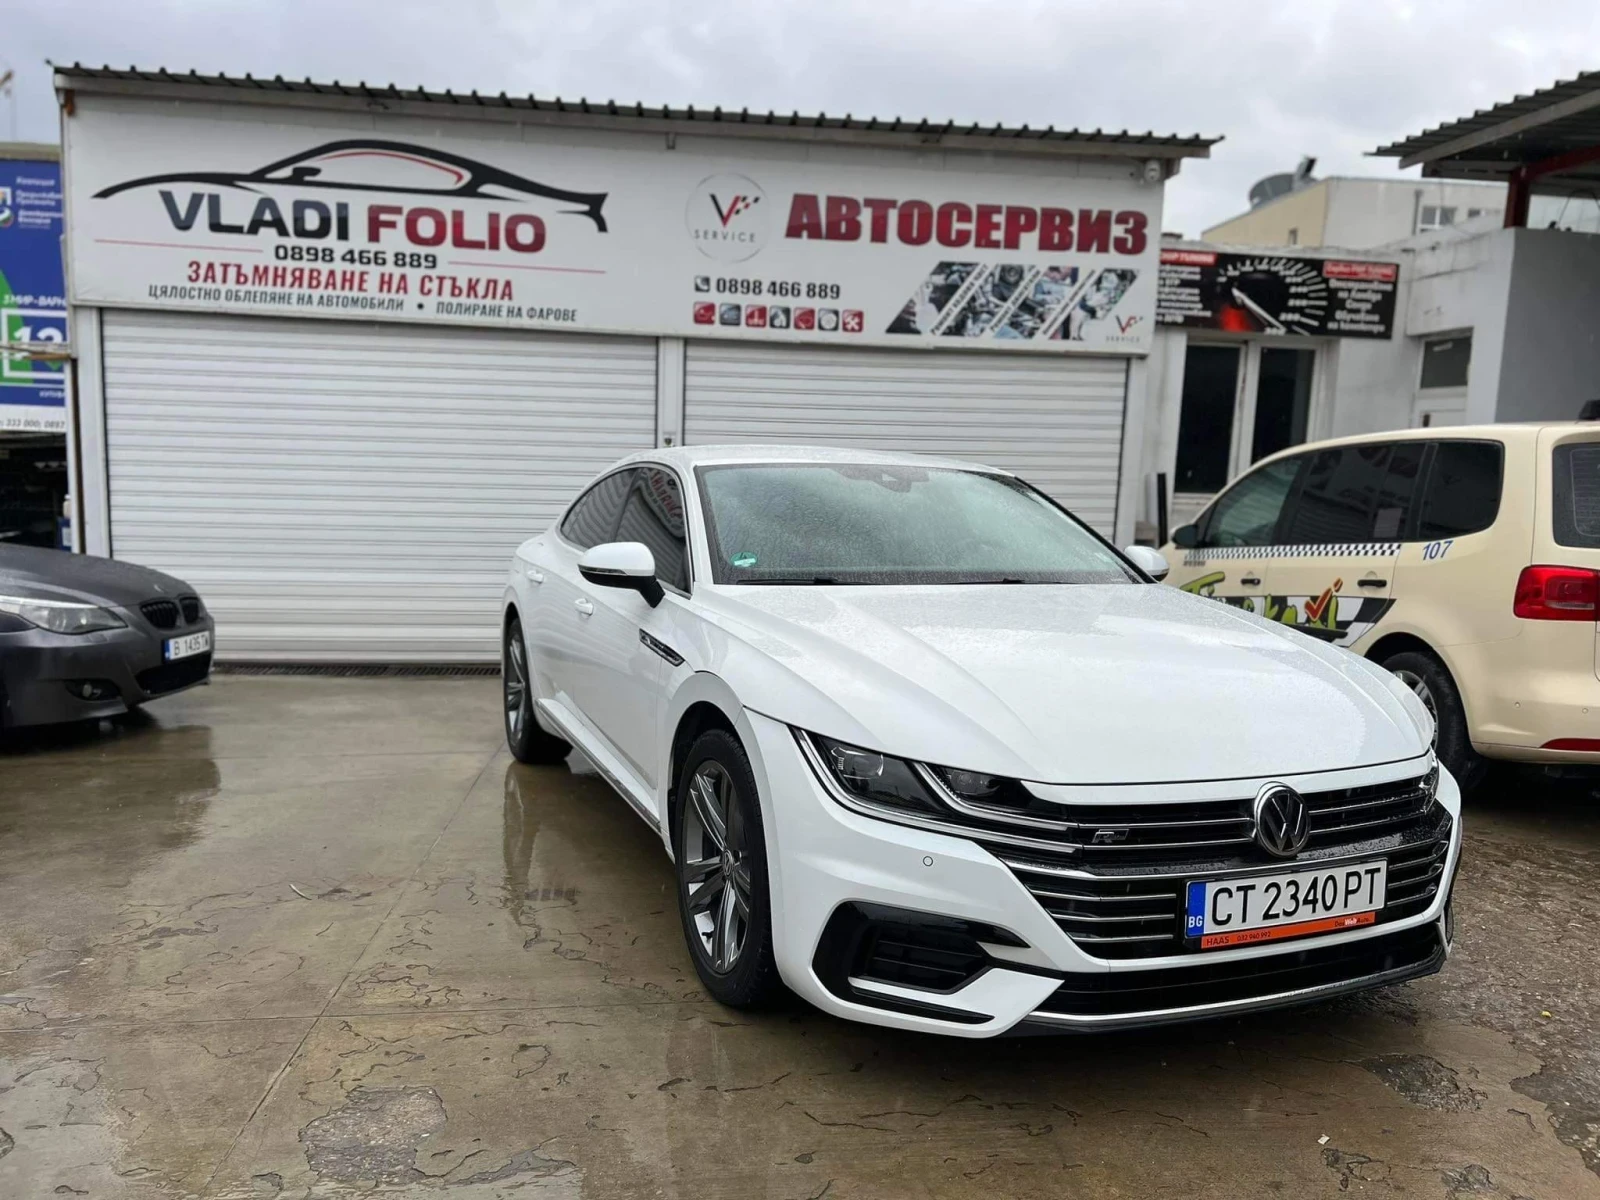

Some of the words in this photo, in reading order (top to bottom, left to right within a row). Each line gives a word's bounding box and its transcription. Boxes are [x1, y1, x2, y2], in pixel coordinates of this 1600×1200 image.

[159, 190, 349, 241] VLADI
[366, 204, 547, 254] FOLIO
[785, 192, 1148, 255] АВТОСЕРВИЗ
[694, 229, 756, 243] SERVICE
[274, 244, 335, 263] 0898
[340, 248, 387, 266] 466
[393, 251, 438, 269] 889
[187, 260, 369, 292] ЗАТЪМНЯВАНЕ
[378, 272, 408, 295] НА
[419, 274, 513, 301] СТЪКЛА
[716, 277, 763, 296] 0898
[767, 280, 802, 298] 466
[806, 283, 841, 300] 889
[148, 285, 221, 301] ЦЯЛОСТНО
[225, 289, 293, 305] ОБЛЕПЯНЕ
[297, 292, 313, 306] НА
[317, 294, 404, 311] АВТОМОБИЛИ
[436, 301, 503, 318] ПОЛИРАНЕ
[506, 305, 523, 319] НА
[526, 306, 578, 322] ФАРОВЕ
[1421, 540, 1453, 560] 107
[174, 641, 180, 656] B
[1211, 883, 1257, 926] CT
[1262, 872, 1338, 921] 2340
[1344, 867, 1382, 909] PT
[1188, 915, 1204, 929] BG
[1206, 937, 1230, 946] HAAS
